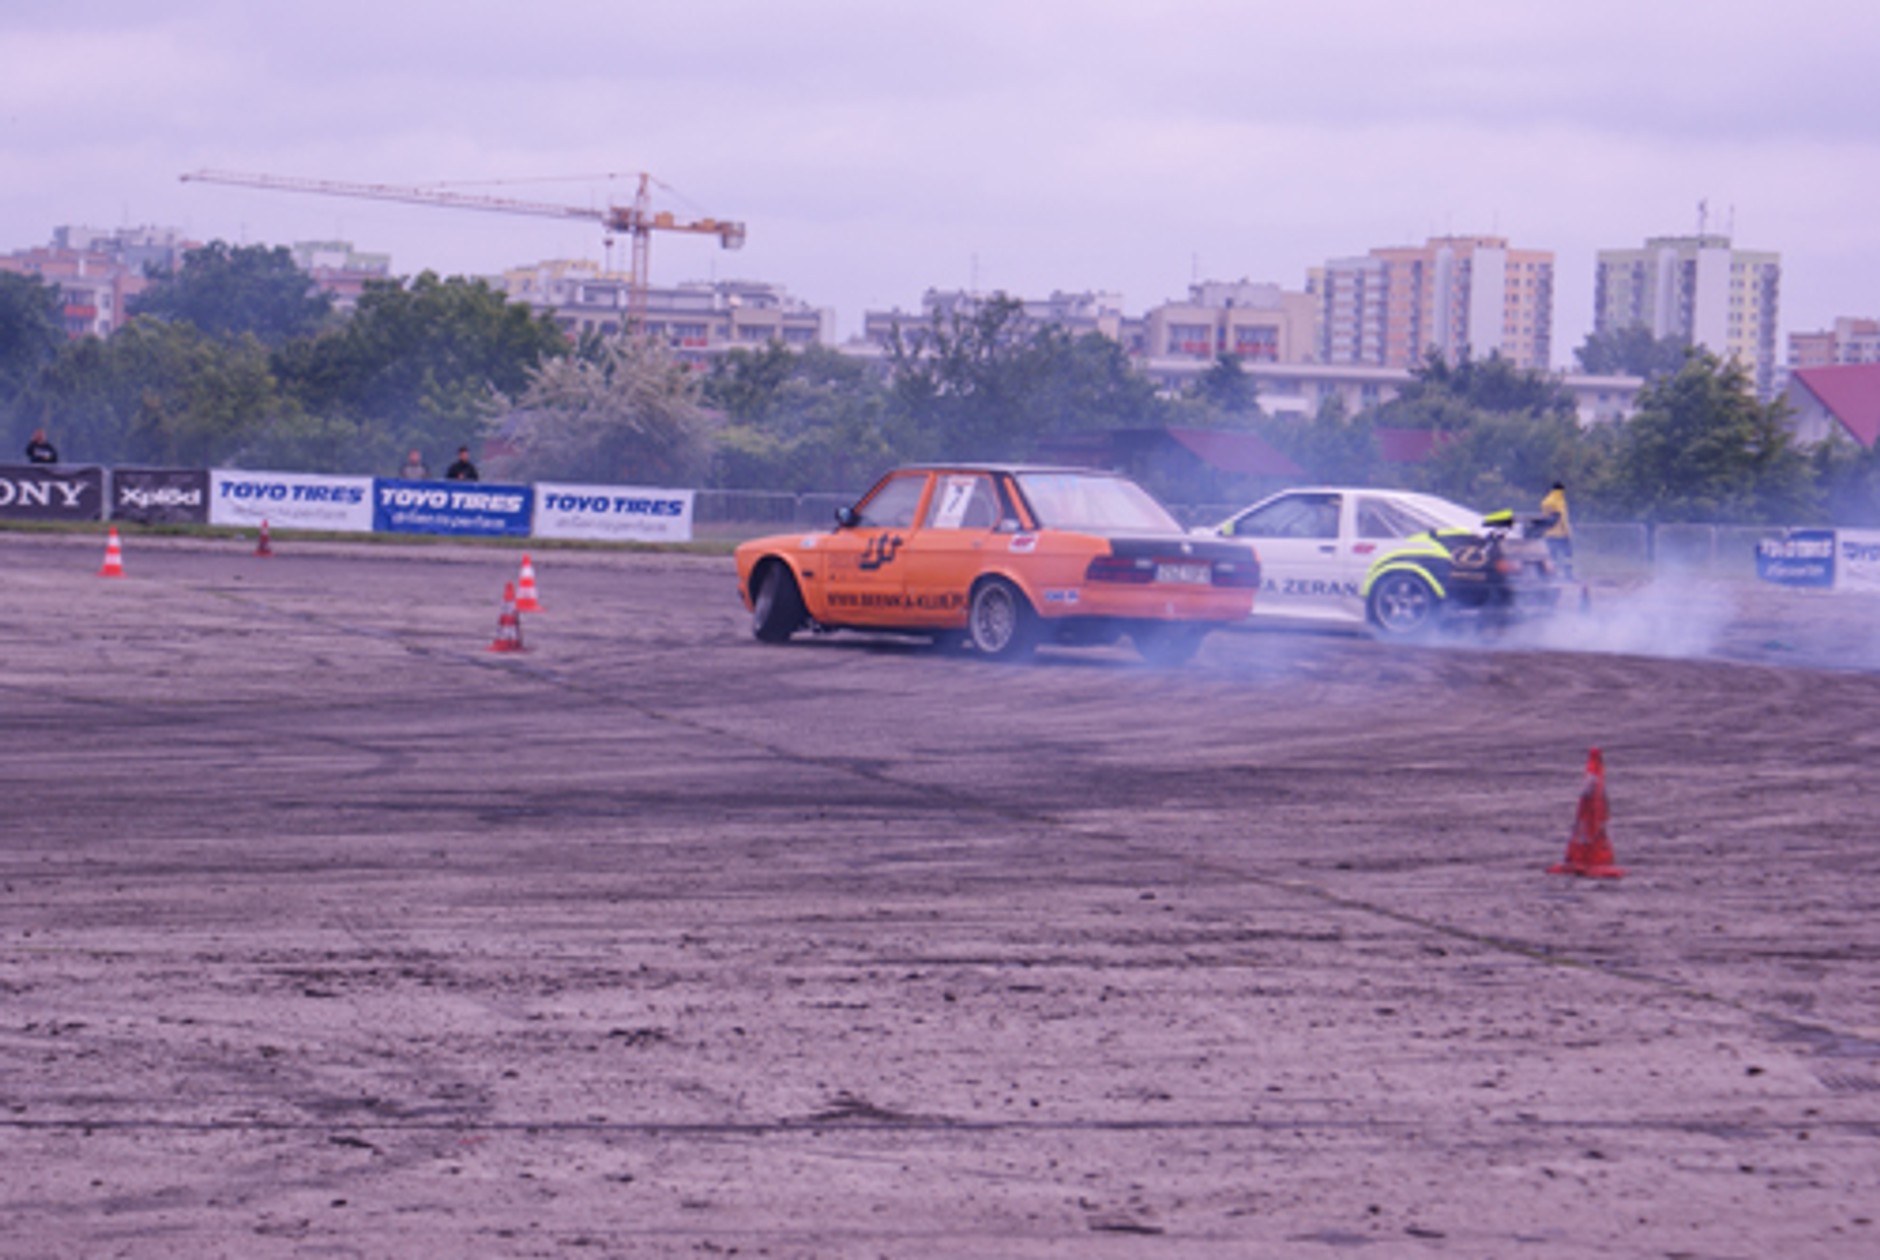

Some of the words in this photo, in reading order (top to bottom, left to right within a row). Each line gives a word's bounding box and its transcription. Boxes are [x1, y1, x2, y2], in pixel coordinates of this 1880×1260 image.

[219, 481, 287, 501] TOYO
[292, 485, 365, 505] TIRES
[380, 488, 448, 509] TOYO
[451, 492, 524, 514] TIRES
[545, 493, 610, 513] TOYO
[613, 497, 685, 516] TIRES
